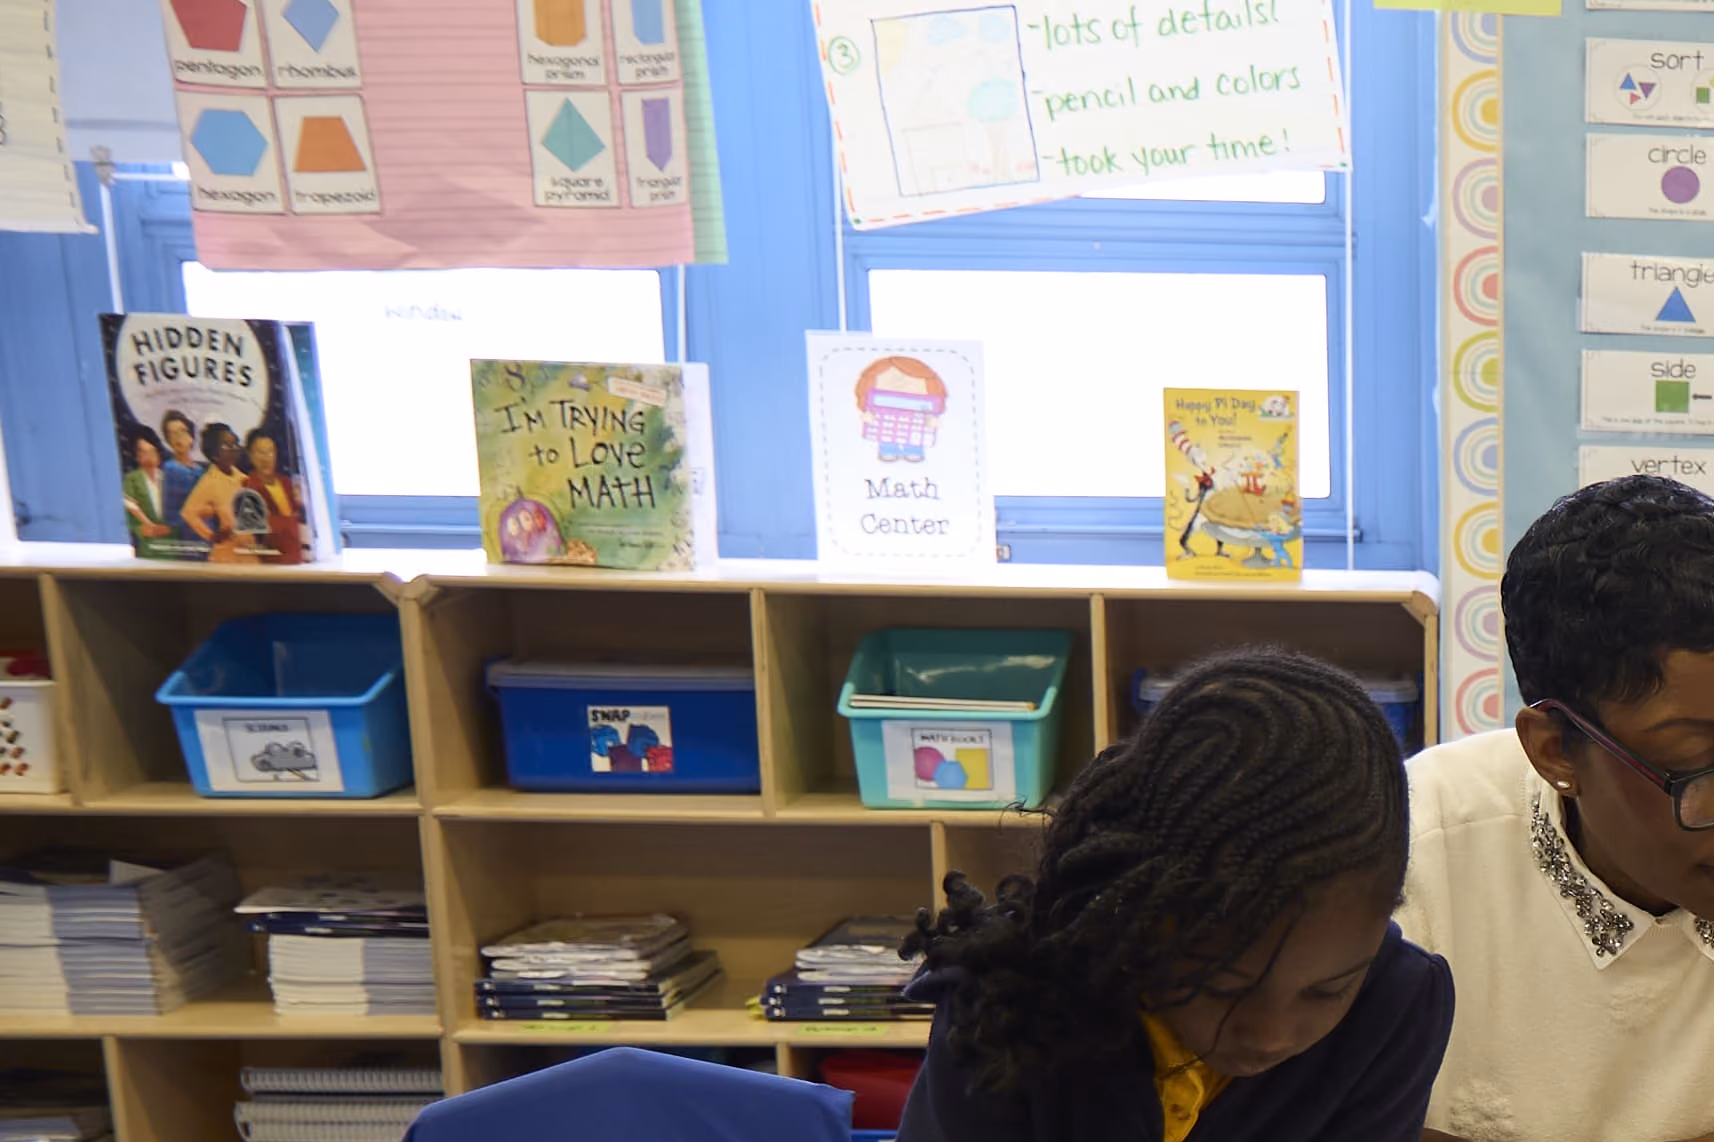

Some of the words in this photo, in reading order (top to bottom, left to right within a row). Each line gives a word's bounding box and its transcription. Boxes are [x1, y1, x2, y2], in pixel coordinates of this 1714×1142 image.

[1111, 5, 1142, 43] of
[1650, 49, 1704, 71] sort
[1149, 71, 1202, 104] and
[1214, 63, 1301, 98] colors
[1131, 142, 1192, 171] your
[1206, 127, 1292, 162] time!
[1648, 144, 1707, 165] circle
[131, 325, 244, 358] HIDDEN
[134, 356, 253, 388] FIGURES
[1651, 357, 1697, 379] side
[549, 399, 645, 437] TRYING
[1176, 398, 1212, 412] Happy
[1214, 397, 1227, 409] Pi
[1231, 397, 1256, 411] Day
[530, 444, 560, 467] to
[1631, 454, 1707, 476] vertex
[864, 475, 941, 502] Math
[859, 510, 950, 538] Center
